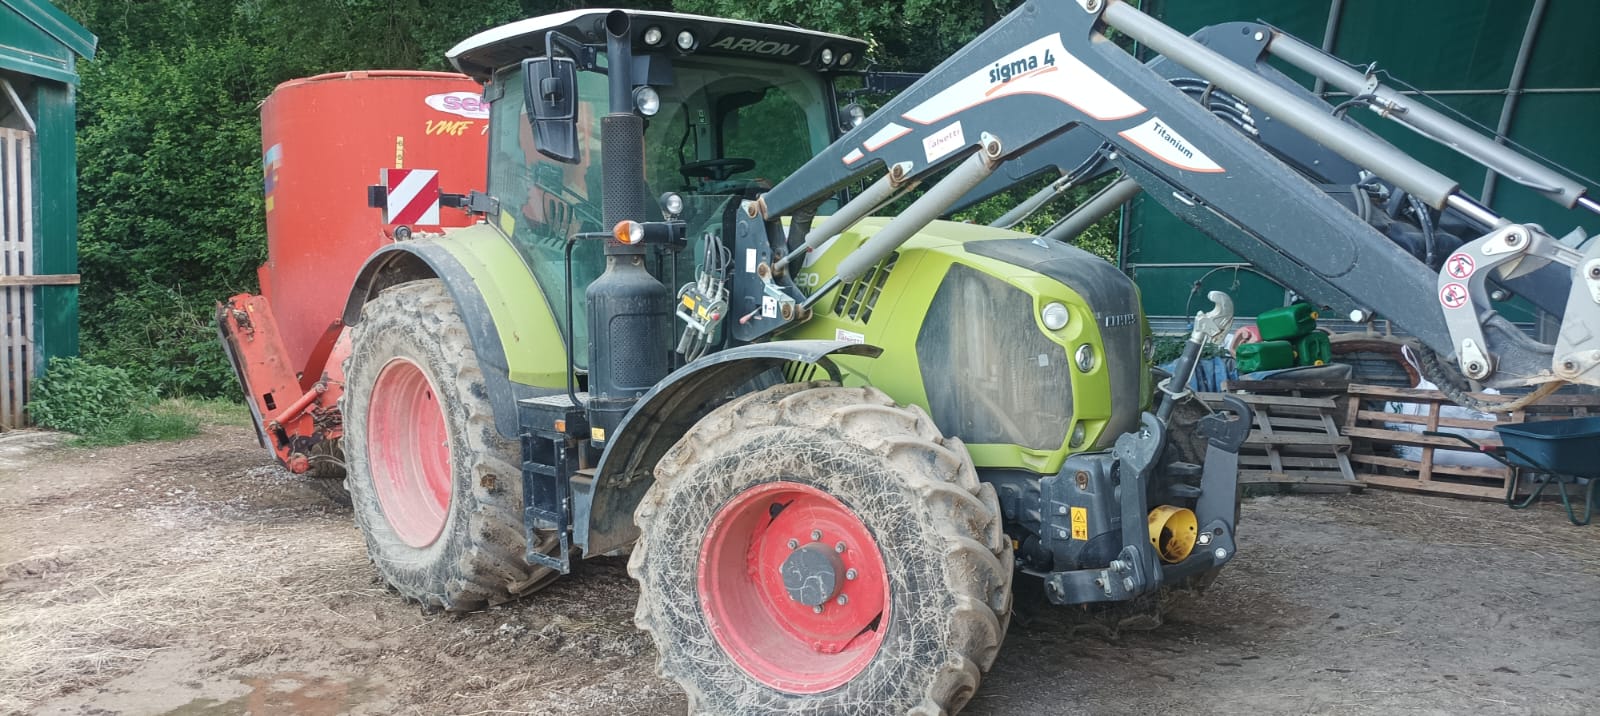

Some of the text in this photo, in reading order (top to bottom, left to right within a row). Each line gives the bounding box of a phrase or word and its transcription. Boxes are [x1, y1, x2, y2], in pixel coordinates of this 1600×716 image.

[709, 36, 800, 56] ARION
[989, 49, 1055, 83] sigma 4
[425, 120, 474, 136] VMF
[1153, 121, 1193, 159] Titanium
